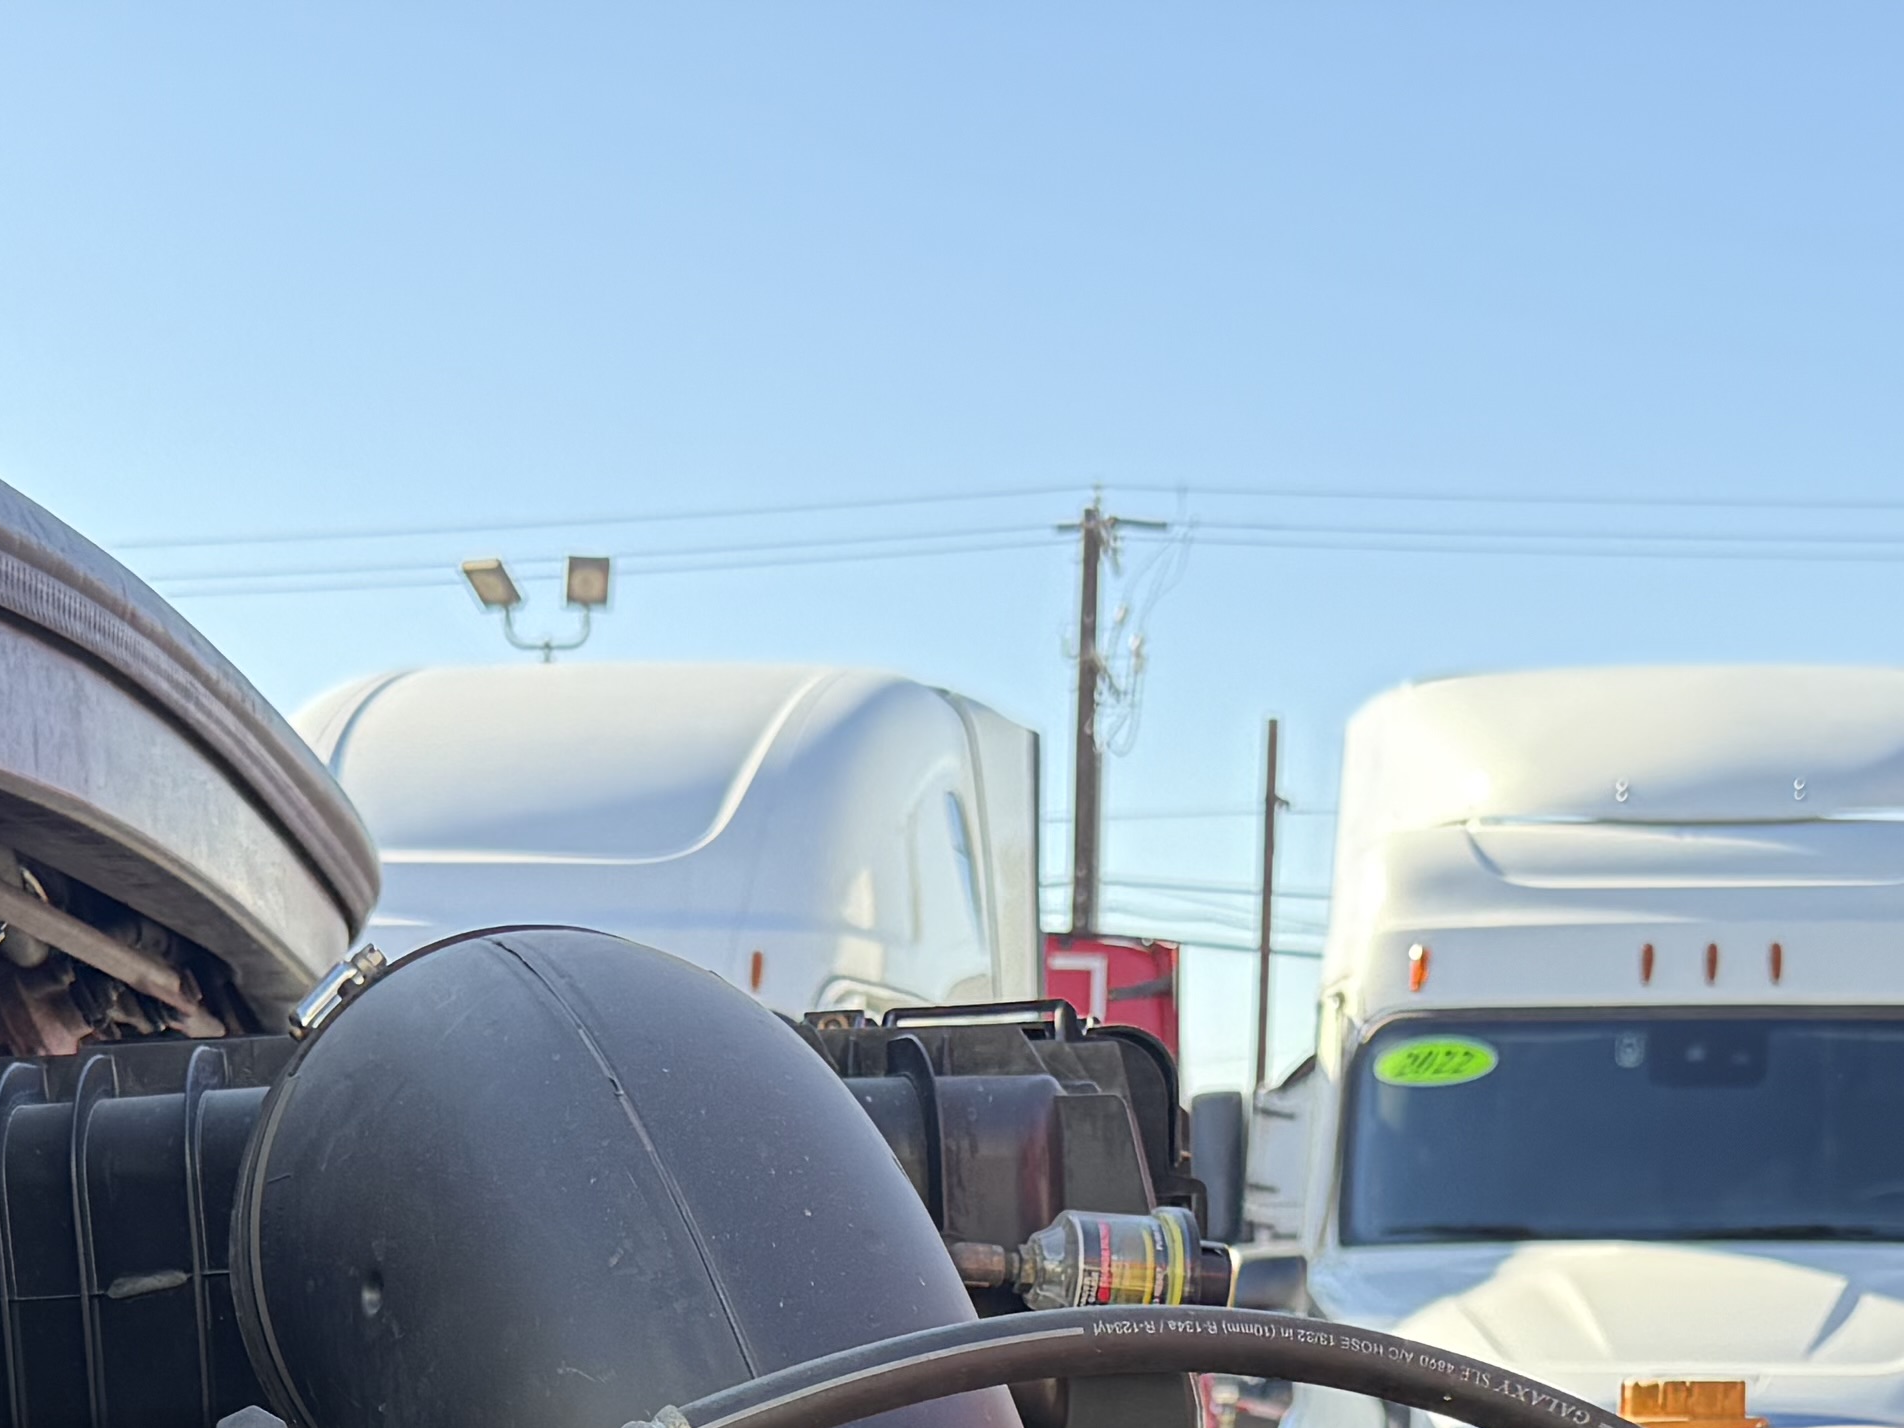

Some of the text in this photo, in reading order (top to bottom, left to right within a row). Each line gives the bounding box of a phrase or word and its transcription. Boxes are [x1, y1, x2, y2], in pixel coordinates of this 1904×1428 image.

[1280, 1327, 1293, 1341] in
[1341, 1336, 1383, 1357] HOSE
[1495, 1380, 1590, 1424] GALAXY
